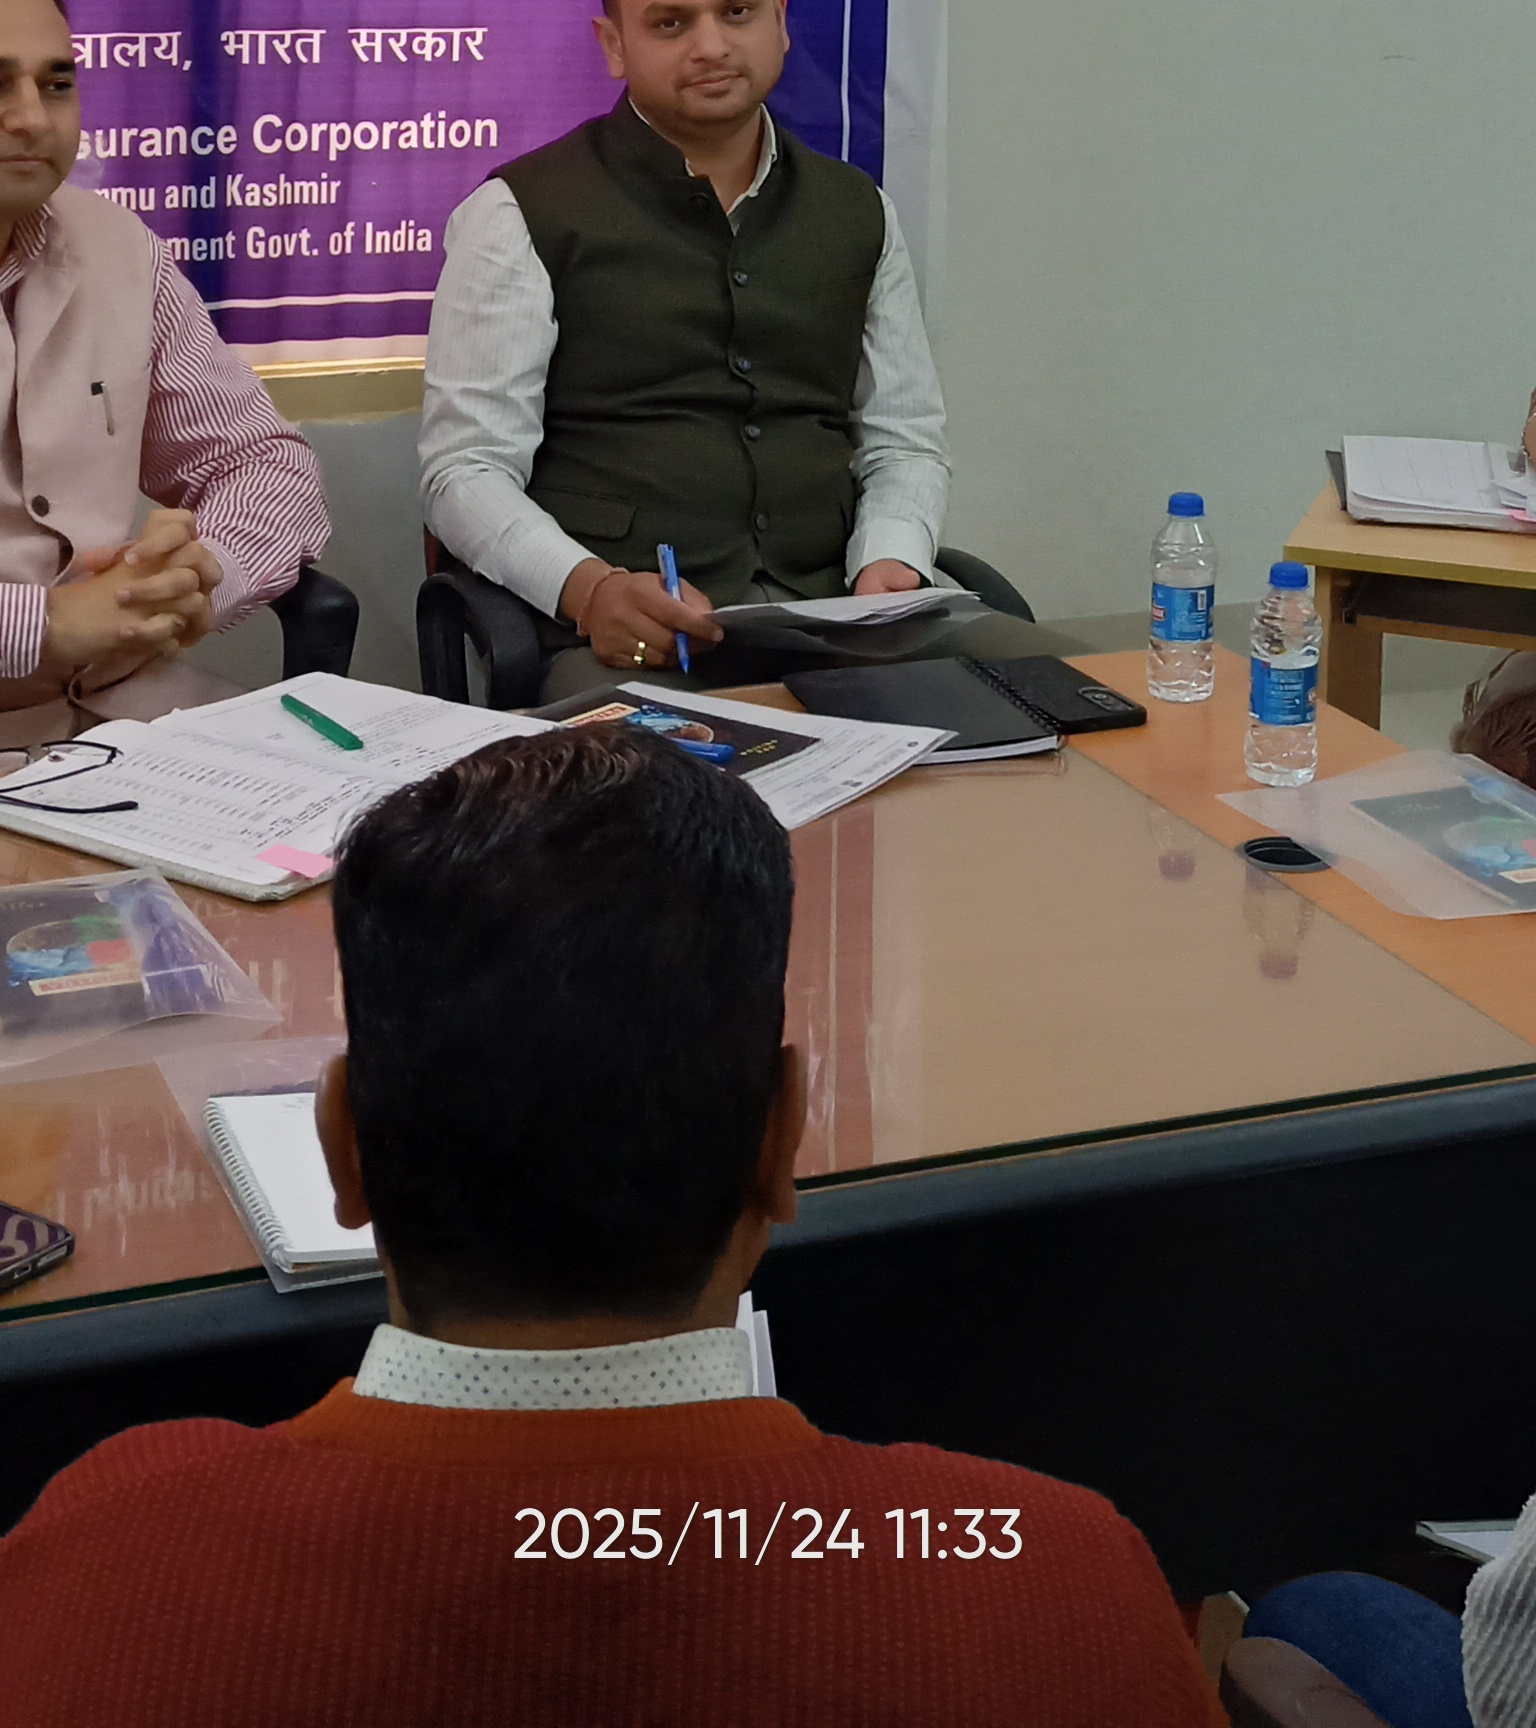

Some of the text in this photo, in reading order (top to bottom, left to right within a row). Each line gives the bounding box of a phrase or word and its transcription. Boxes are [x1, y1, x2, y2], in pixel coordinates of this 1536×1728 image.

[221, 30, 326, 64] भारत
[348, 28, 488, 62] सरकार
[77, 111, 497, 160] surance Corporation
[165, 177, 215, 208] and
[227, 173, 340, 206] Kashmir
[247, 227, 318, 258] Govt.
[330, 222, 355, 255] of
[366, 220, 431, 253] India
